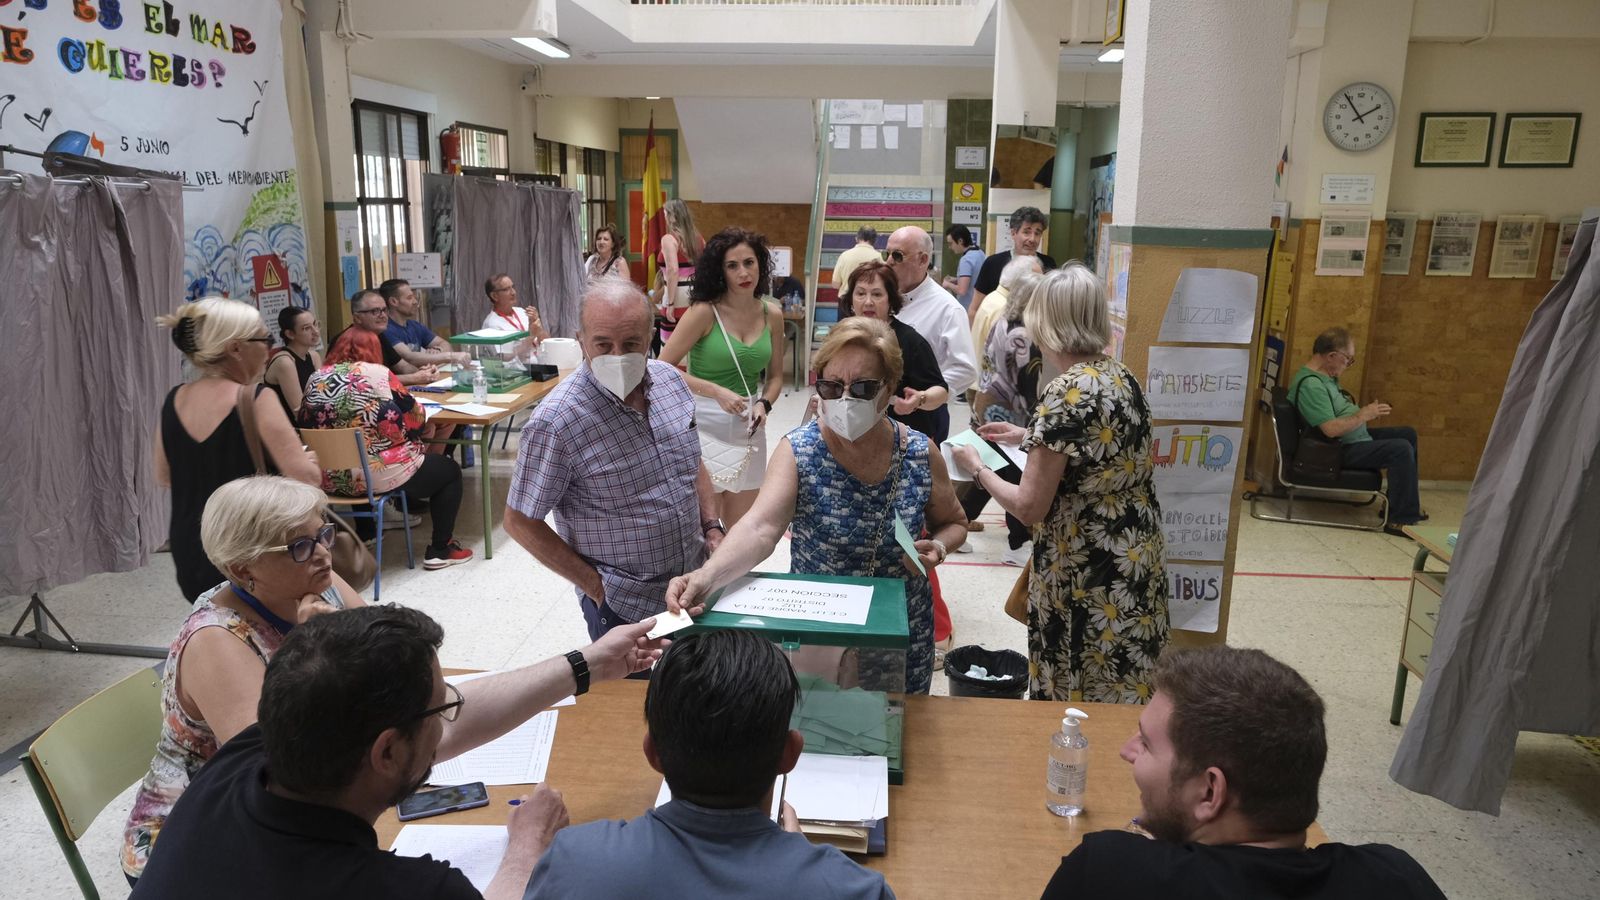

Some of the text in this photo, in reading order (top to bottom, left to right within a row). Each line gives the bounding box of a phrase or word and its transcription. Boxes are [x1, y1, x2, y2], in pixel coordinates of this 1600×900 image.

[143, 0, 180, 37] EL
[189, 12, 257, 55] MAR
[120, 136, 170, 155] 5 JUNIO
[196, 171, 222, 185] DEL
[833, 189, 923, 199] Y SOMOS FELICES
[1148, 367, 1243, 395] MATASIETE
[776, 598, 826, 606] DISTRITO
[769, 606, 807, 614] MADRE
